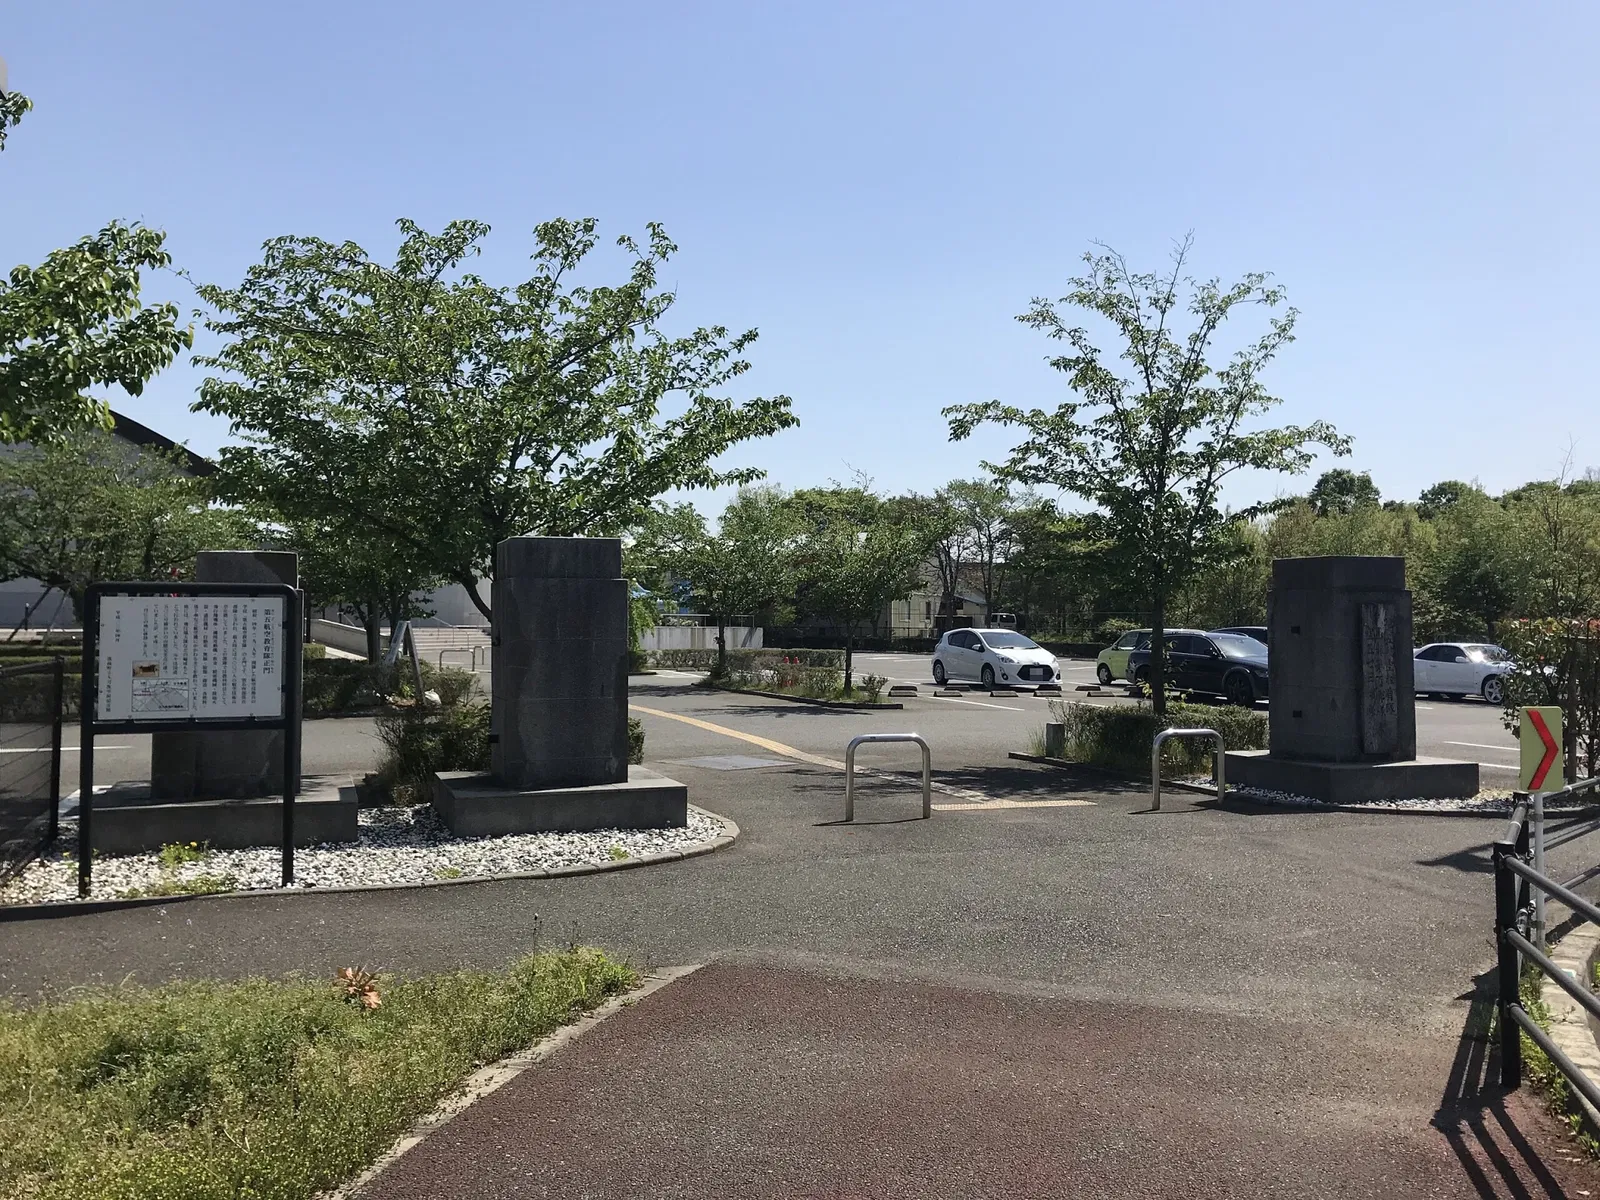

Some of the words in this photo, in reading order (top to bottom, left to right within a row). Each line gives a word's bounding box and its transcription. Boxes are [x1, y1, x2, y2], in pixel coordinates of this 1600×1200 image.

[263, 608, 271, 674] 第五航空教育隊正門
